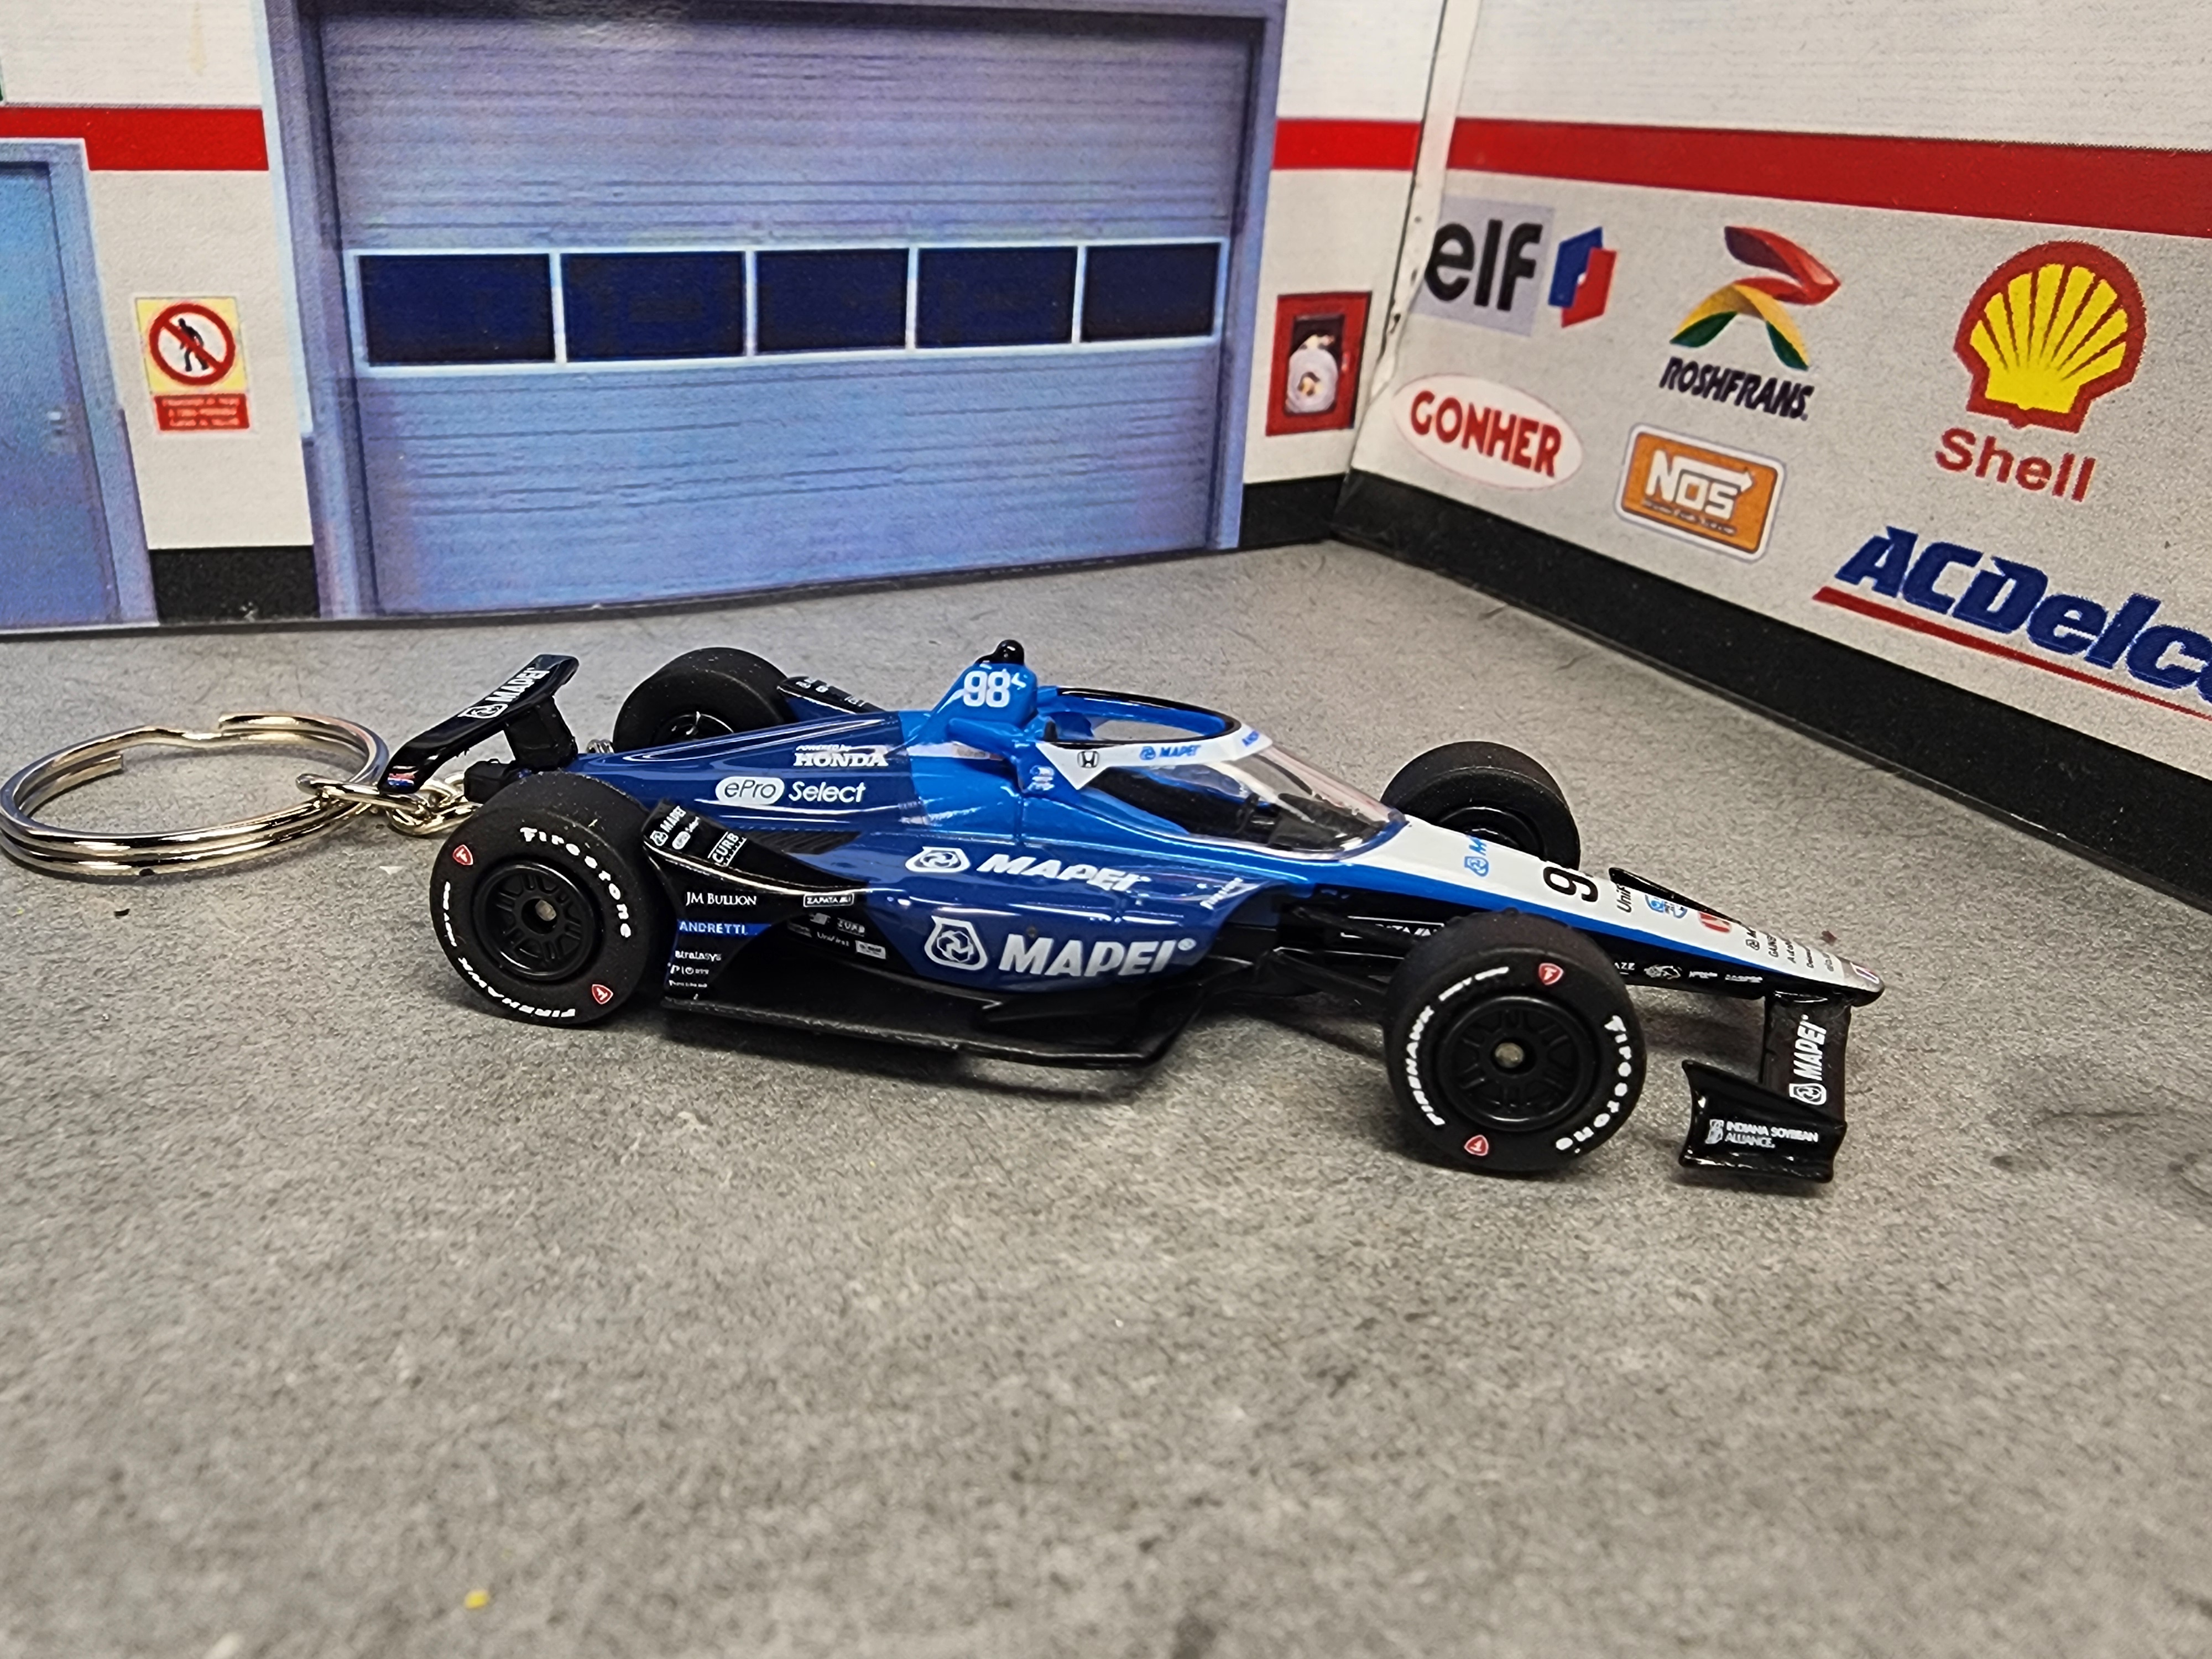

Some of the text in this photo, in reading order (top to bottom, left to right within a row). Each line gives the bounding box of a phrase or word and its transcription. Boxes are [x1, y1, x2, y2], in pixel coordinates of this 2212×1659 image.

[1424, 218, 1543, 311] elf
[1660, 357, 1814, 420] ROSHFRANS
[1411, 390, 1562, 478] GONHER
[1645, 449, 1753, 520] NOS
[1934, 427, 2096, 502] Shell
[1834, 526, 2212, 705] ACDelc
[963, 670, 1011, 708] 98
[793, 753, 889, 766] HONDA
[724, 780, 866, 803] ePro Select
[712, 832, 739, 863] CURB
[976, 853, 1143, 891] MAPEI
[1543, 865, 1599, 902] 9
[686, 891, 705, 906] JM
[679, 920, 745, 935] ANDRETTI
[998, 933, 1178, 977] MAPEI
[1793, 1020, 1827, 1081] MAPEI
